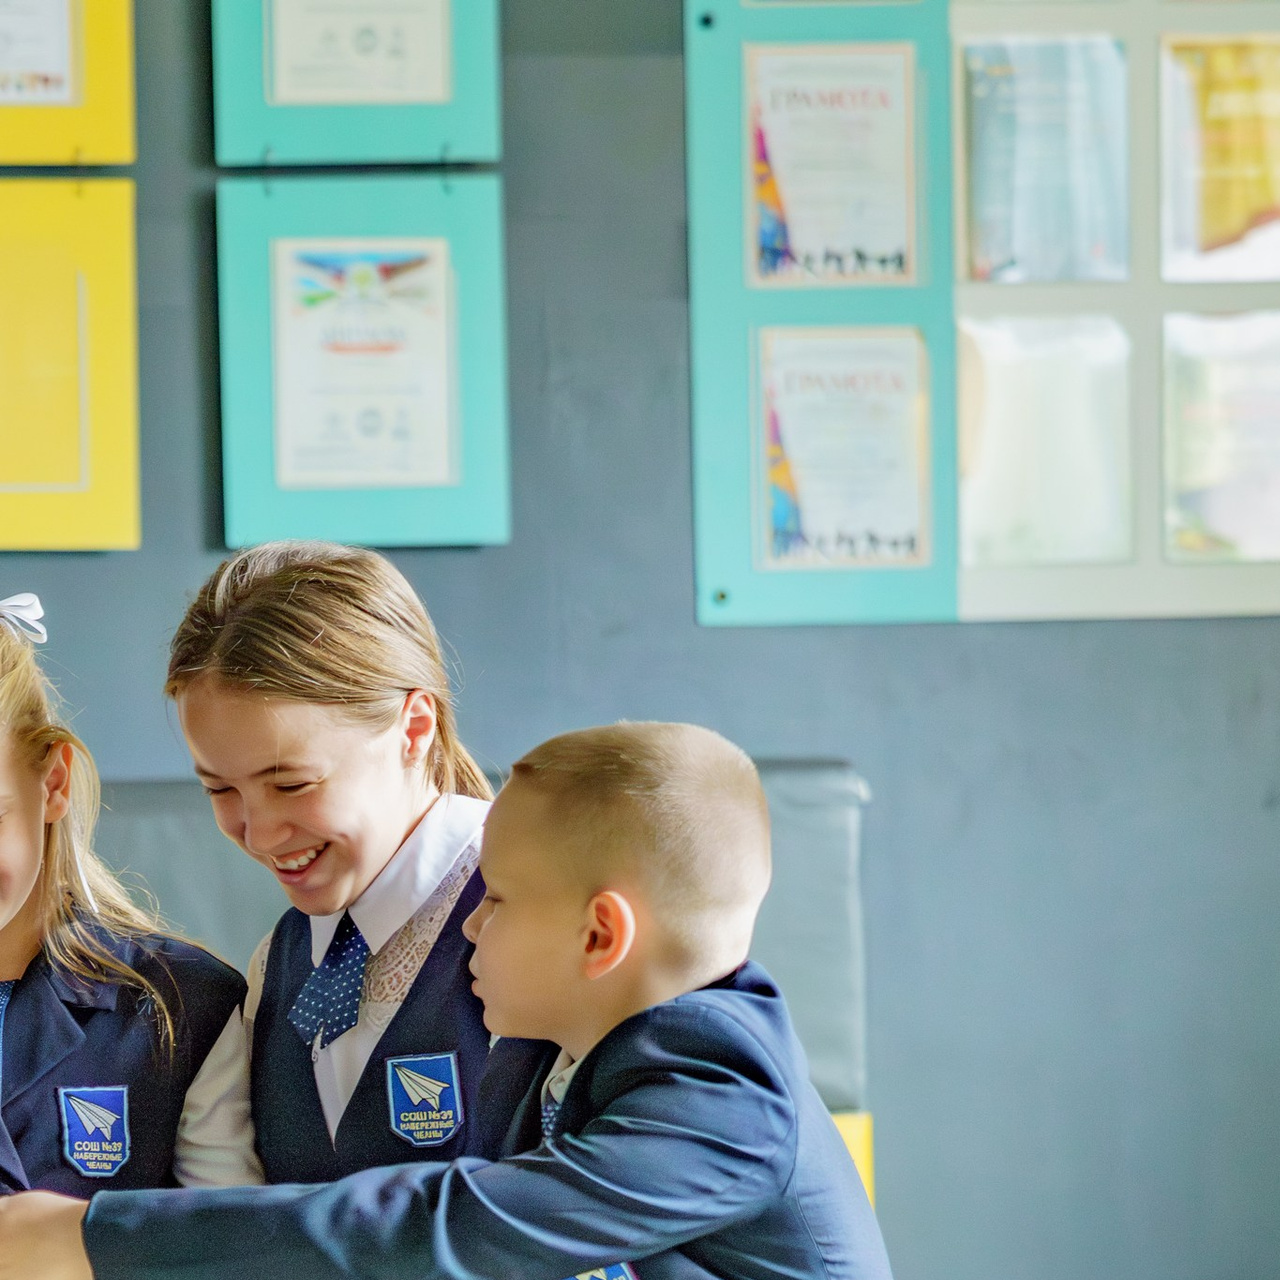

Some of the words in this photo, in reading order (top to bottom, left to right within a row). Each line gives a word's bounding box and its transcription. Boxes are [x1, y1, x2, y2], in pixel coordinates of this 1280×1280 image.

[769, 86, 892, 112] ГРАМОТА
[400, 1111, 426, 1122] СОШ
[428, 1110, 453, 1121] №39
[413, 1130, 443, 1139] ЧЕЛНЫ
[74, 1141, 100, 1151] СОШ
[102, 1141, 122, 1151] №39
[86, 1162, 112, 1170] ЧЕЛНЫ
